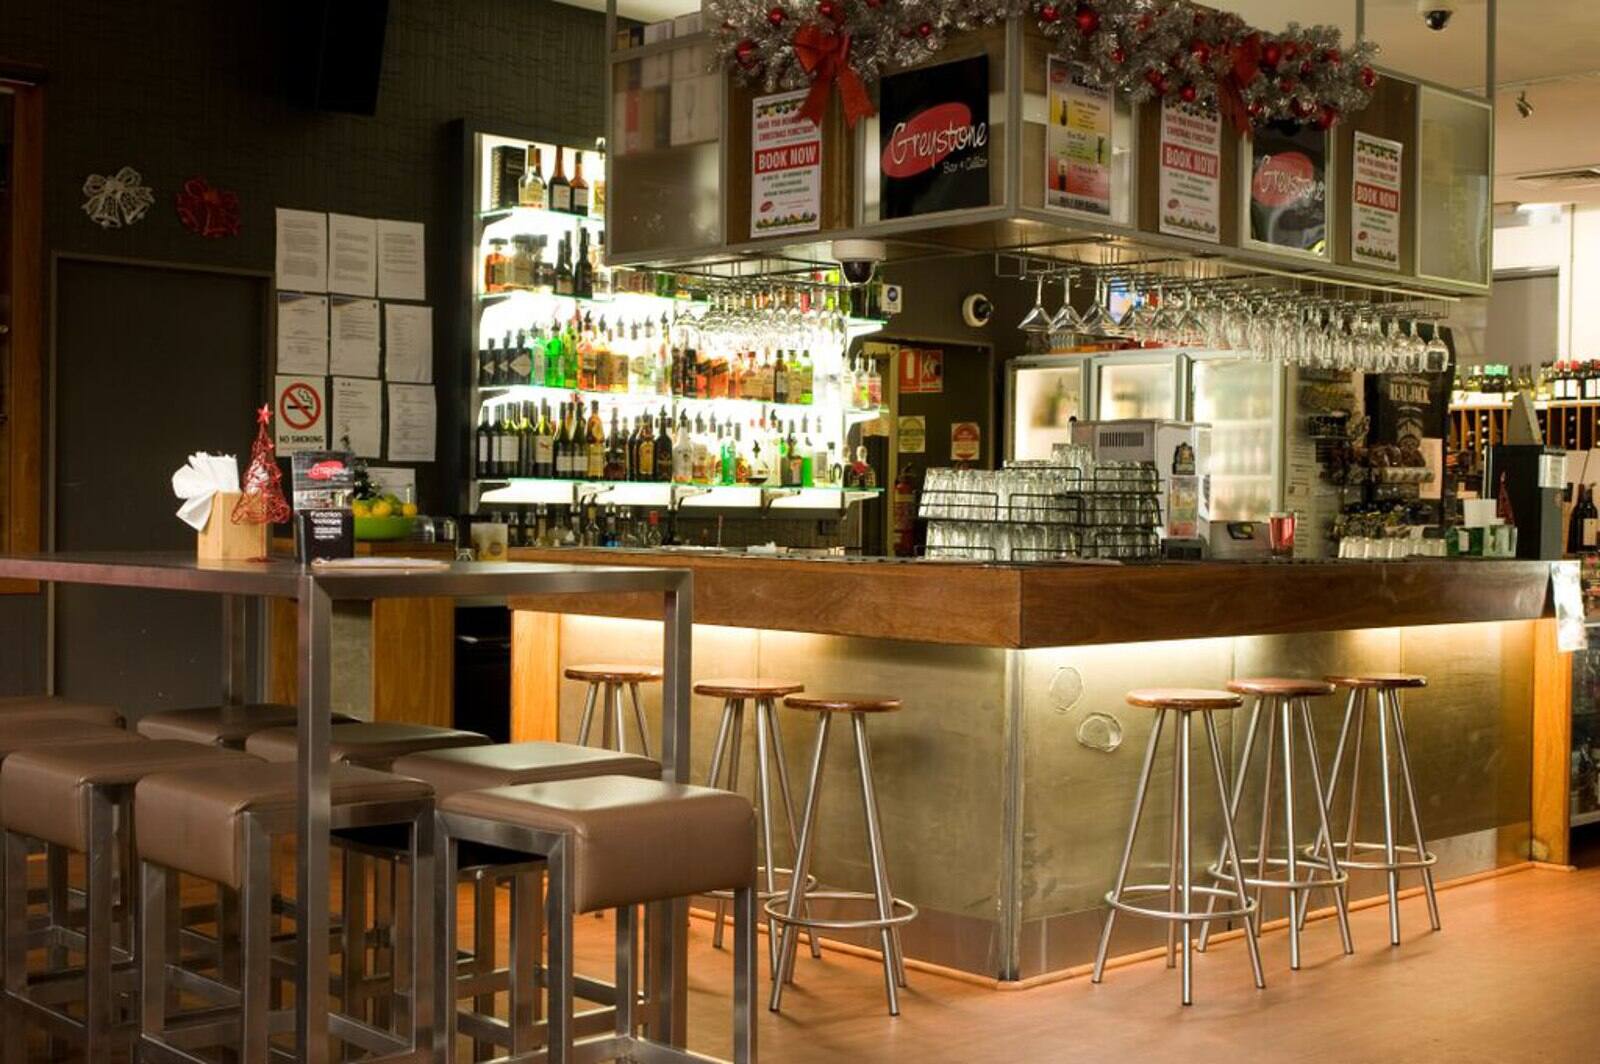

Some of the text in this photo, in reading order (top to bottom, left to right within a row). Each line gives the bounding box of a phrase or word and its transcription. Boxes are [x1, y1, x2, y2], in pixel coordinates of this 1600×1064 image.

[758, 144, 817, 171] BOOK NOW
[891, 121, 987, 169] Greystone
[1166, 146, 1216, 176] BOOK NOW
[1357, 184, 1397, 210] BOOK NOW
[279, 435, 324, 444] NO SMOKING
